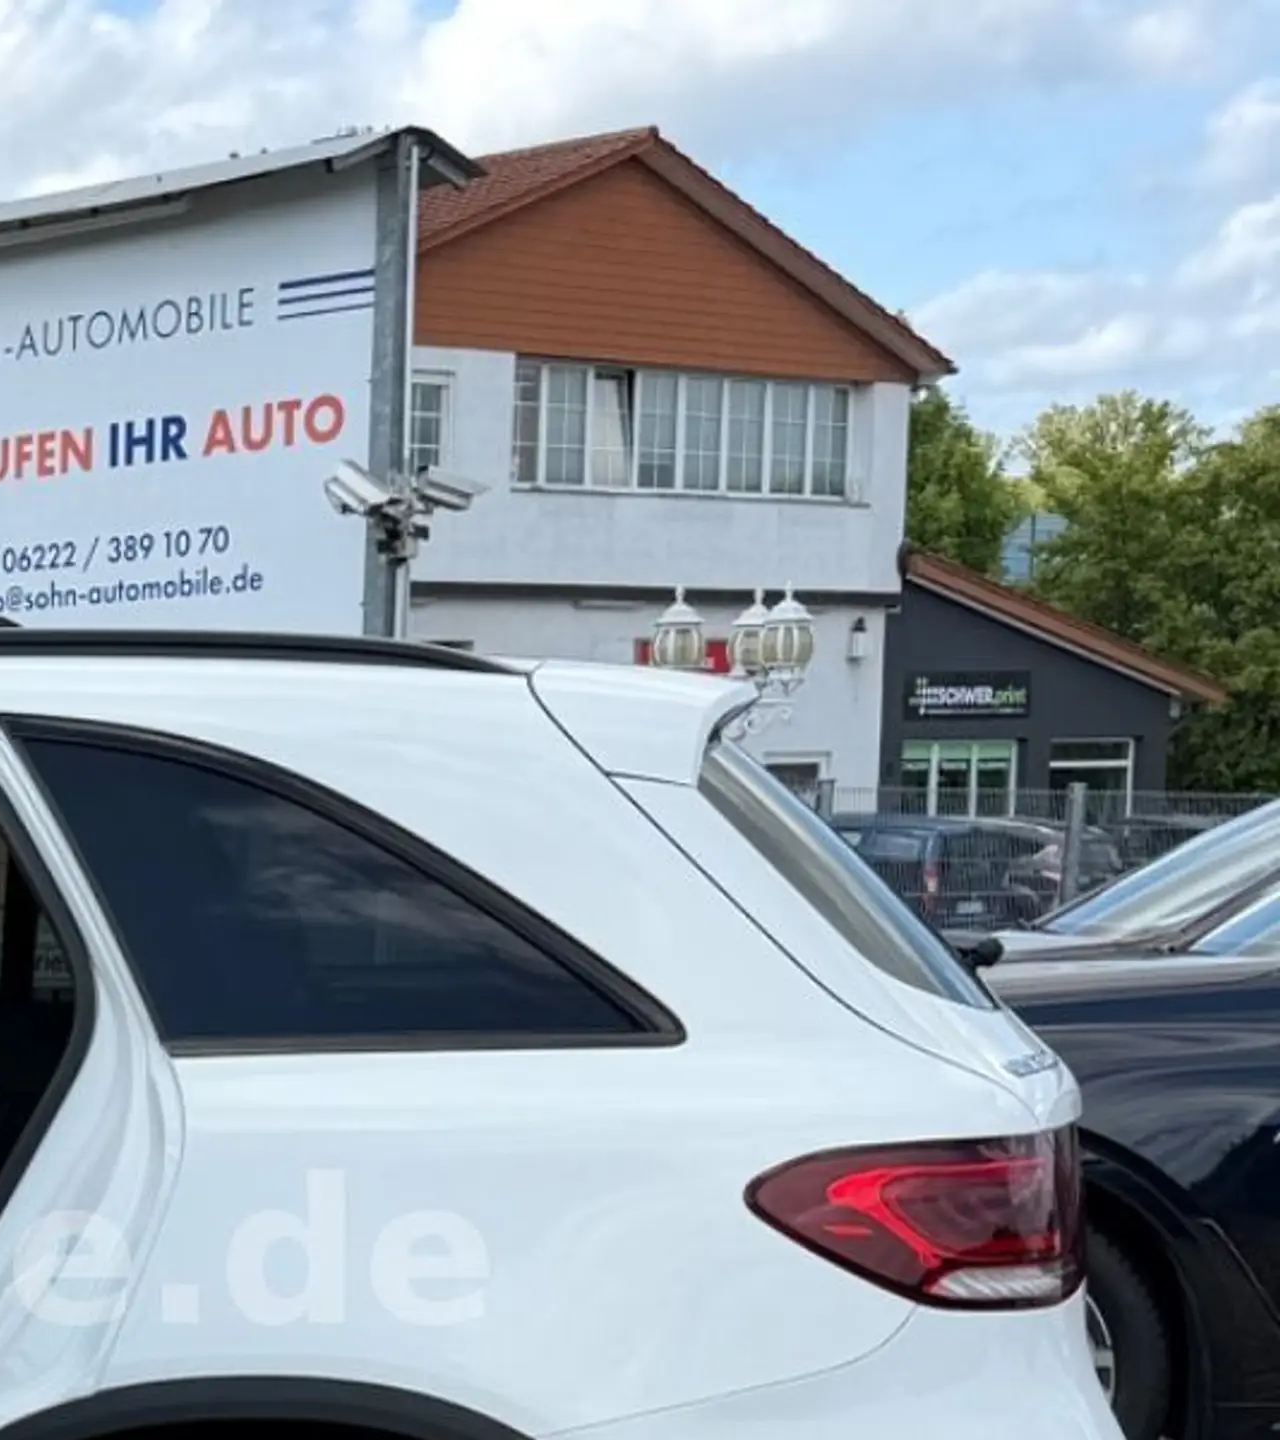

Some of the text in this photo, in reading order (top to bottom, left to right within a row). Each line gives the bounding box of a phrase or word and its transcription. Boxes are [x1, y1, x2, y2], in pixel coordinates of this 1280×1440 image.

[108, 414, 189, 468] IHR
[201, 393, 346, 457] AUTO
[2, 541, 78, 574] 06222
[82, 535, 100, 572] /
[106, 533, 155, 564] 389
[163, 529, 190, 559] 10
[197, 525, 231, 554] 70
